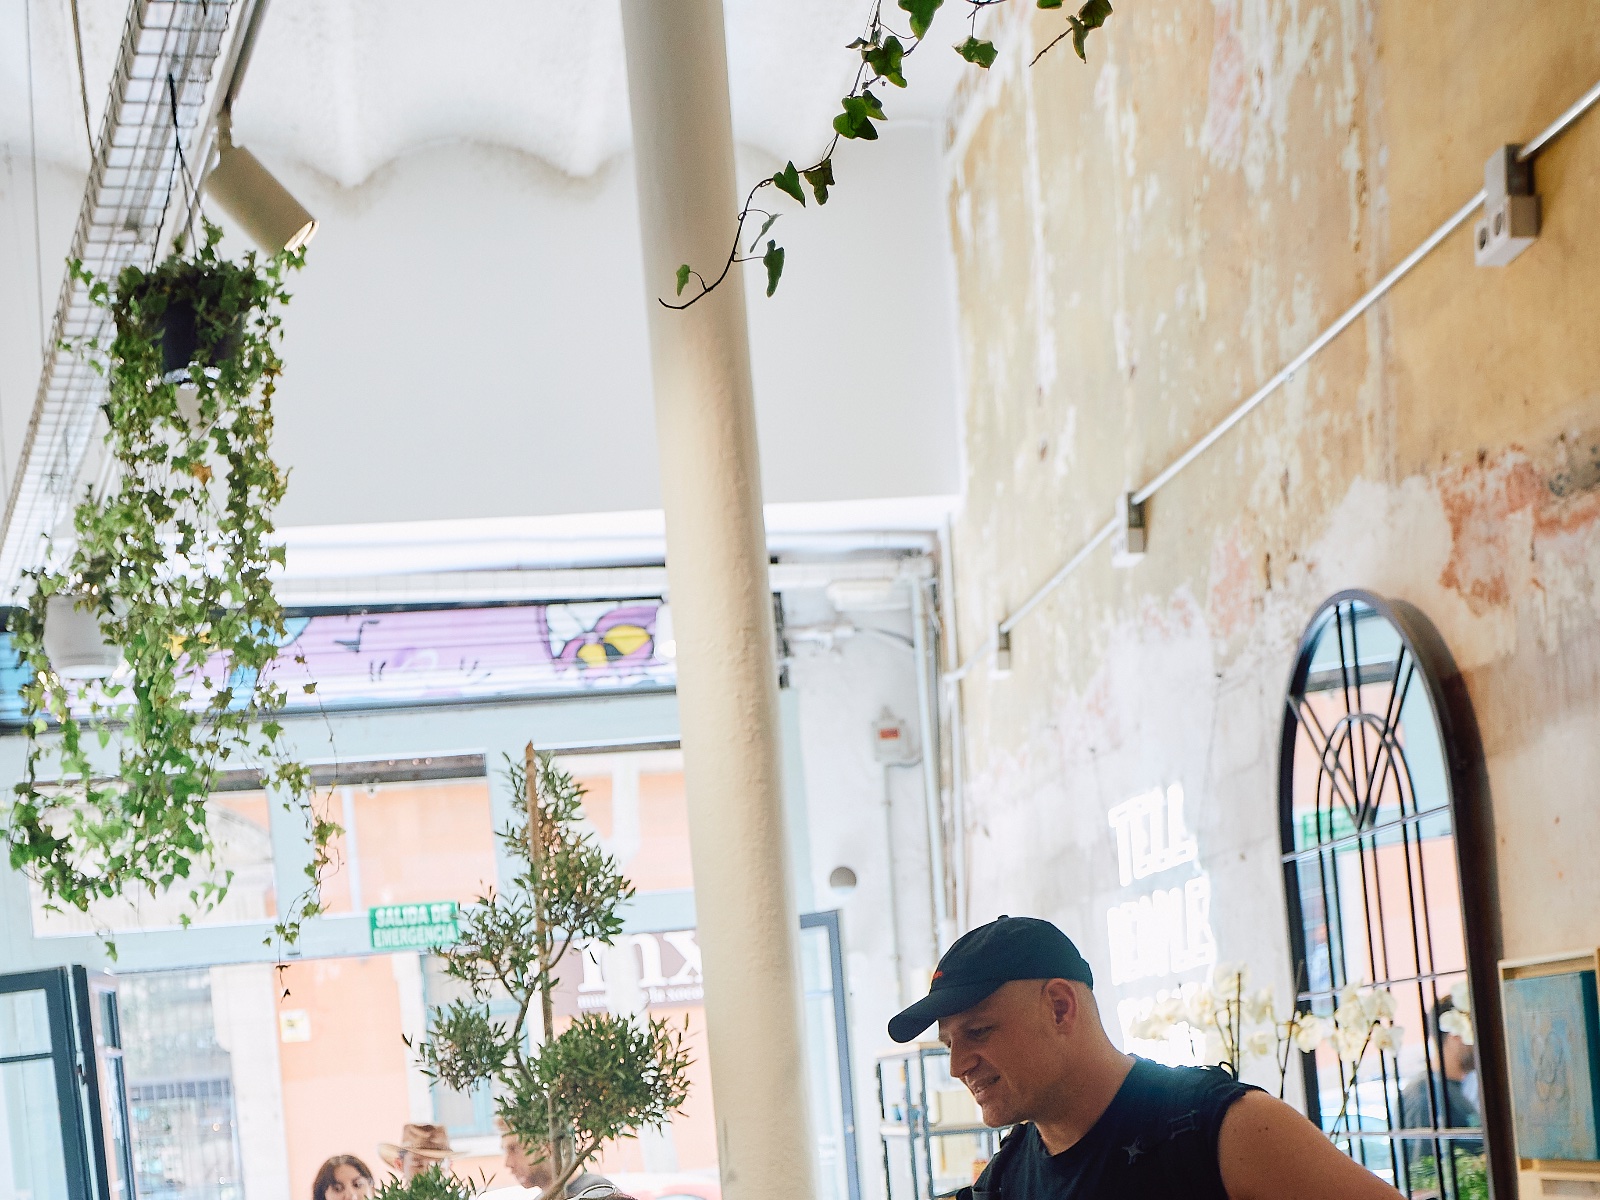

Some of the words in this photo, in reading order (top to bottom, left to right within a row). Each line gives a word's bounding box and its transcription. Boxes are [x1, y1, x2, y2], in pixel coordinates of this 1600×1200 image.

[1108, 782, 1199, 886] TELL
[375, 905, 429, 927] SALIDA
[430, 902, 452, 923] DE
[373, 922, 459, 948] EMERGENCIA
